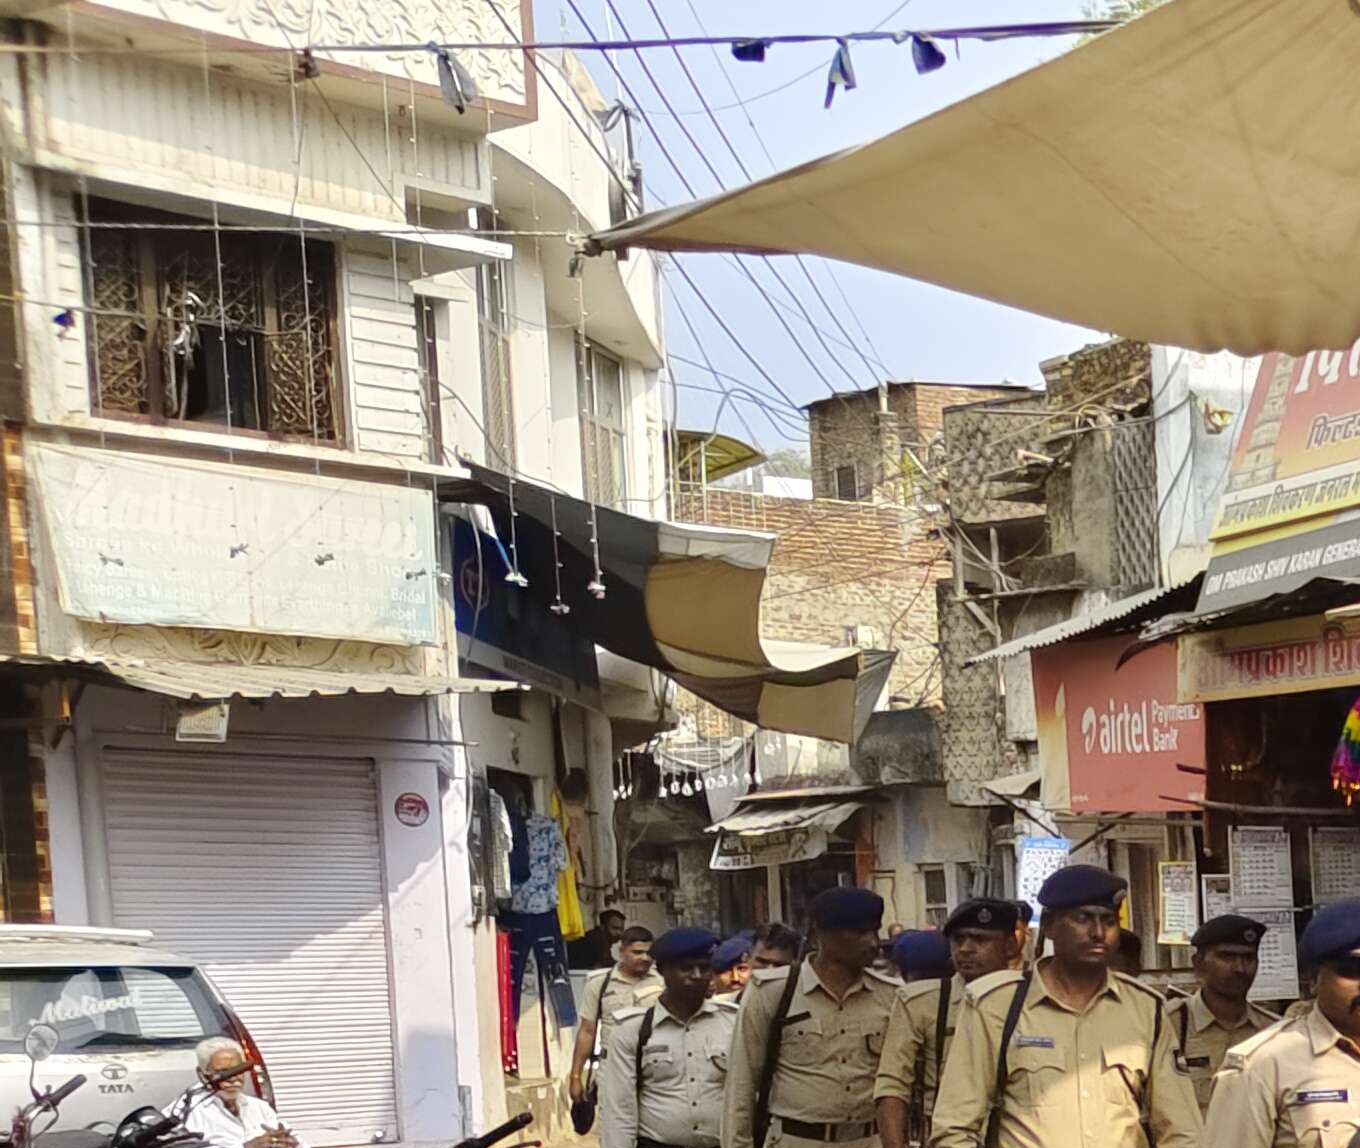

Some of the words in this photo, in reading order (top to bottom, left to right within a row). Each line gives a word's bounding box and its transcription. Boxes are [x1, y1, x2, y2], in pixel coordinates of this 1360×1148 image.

[1222, 561, 1265, 592] PRAKASH
[1264, 555, 1288, 581] SHIV
[1288, 547, 1323, 576] KARAN
[1099, 697, 1151, 755] airtel
[1153, 725, 1179, 753] Bank
[98, 1084, 134, 1095] TATA
